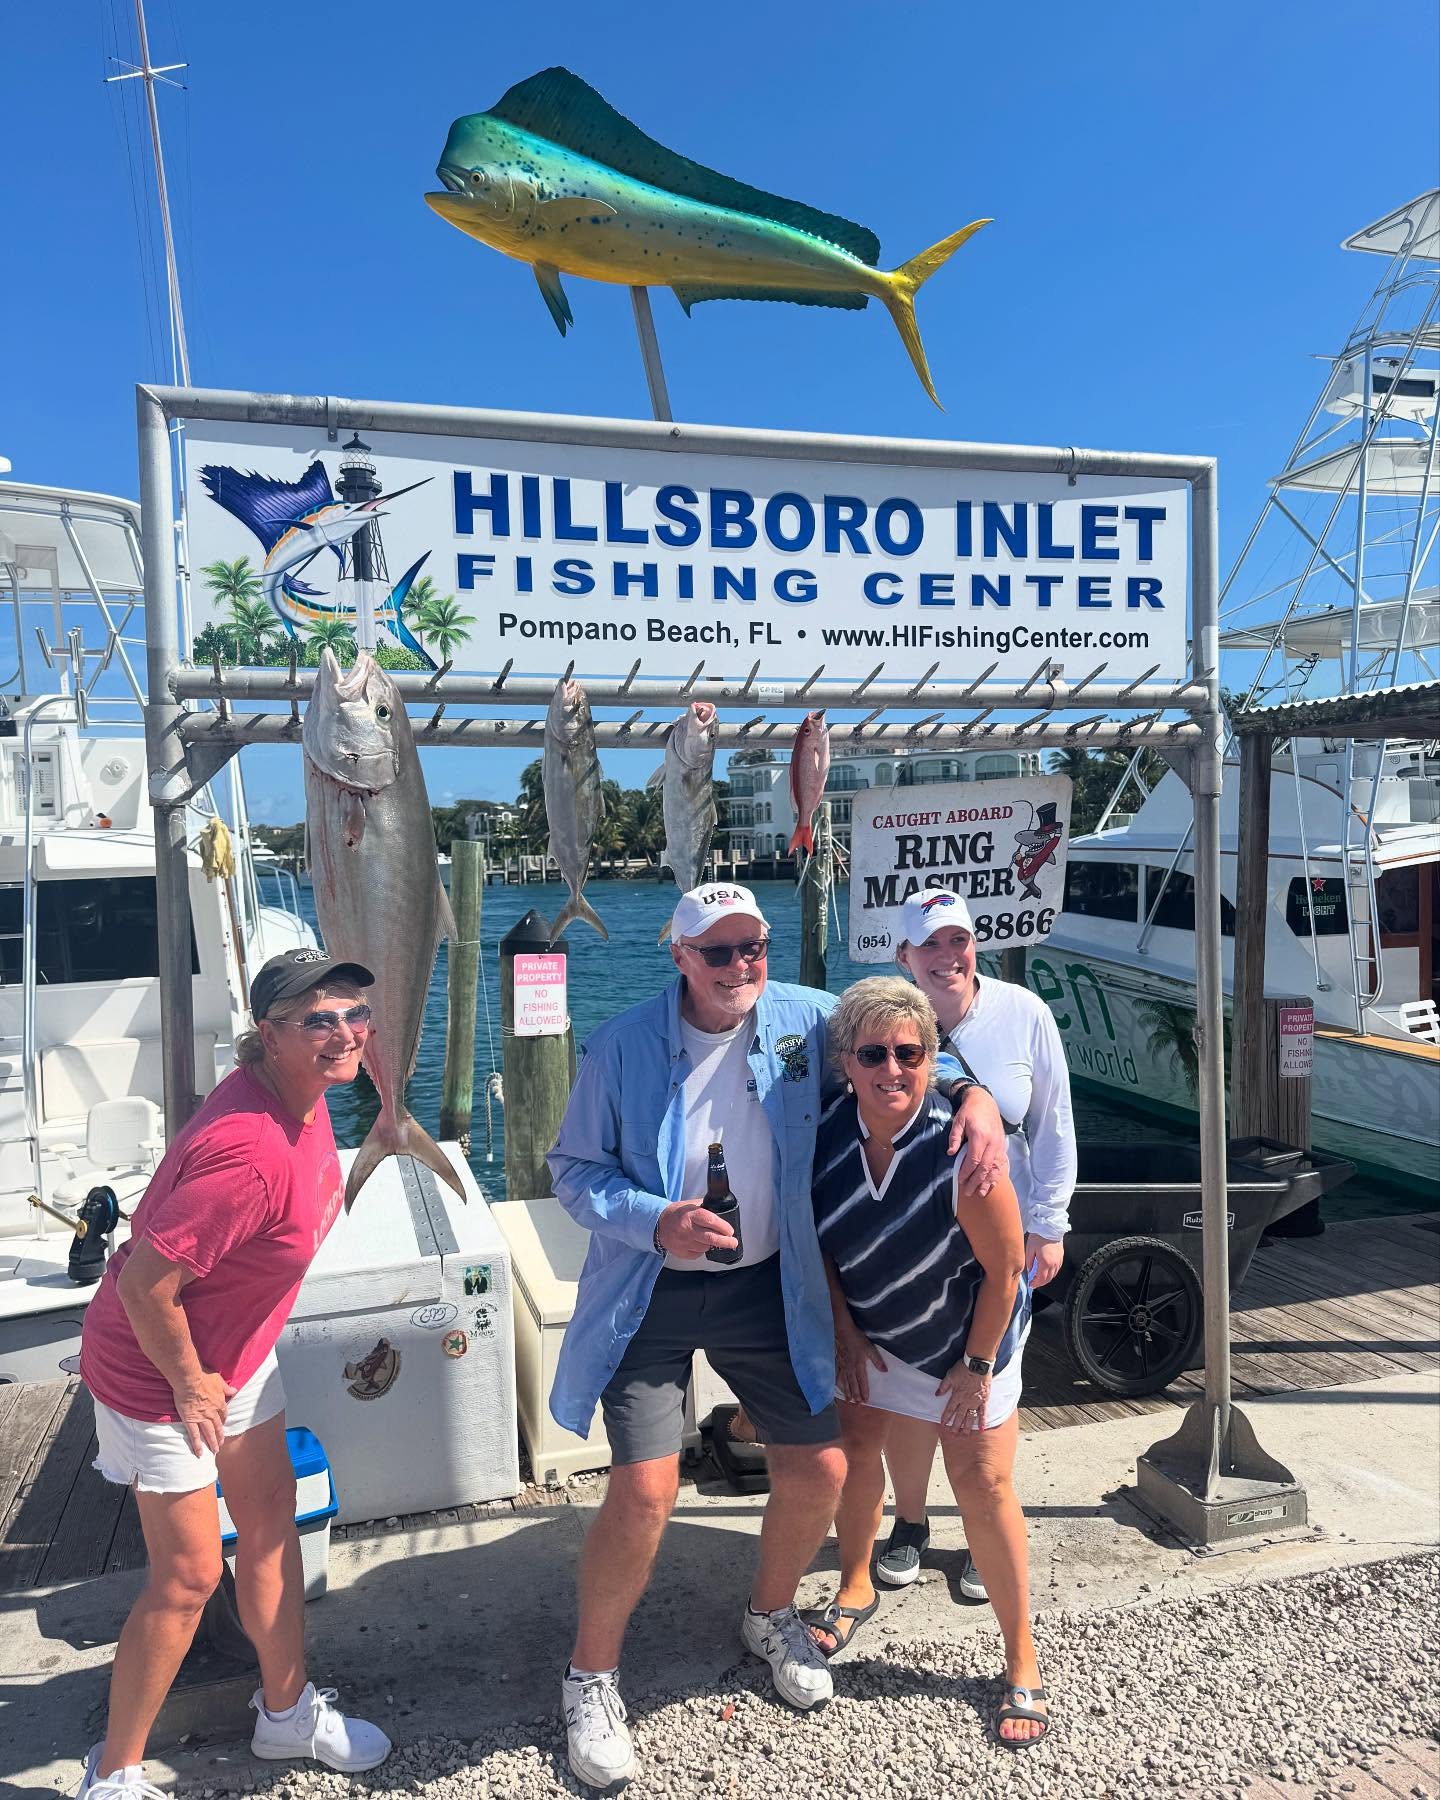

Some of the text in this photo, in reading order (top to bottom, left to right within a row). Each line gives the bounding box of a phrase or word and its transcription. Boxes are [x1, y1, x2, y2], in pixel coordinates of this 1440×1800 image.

[453, 469, 1167, 561] HILLSBORO INLET
[456, 553, 1166, 609] FISHING CENTER
[499, 613, 1149, 653] Pompano Beach, FL www.HIFishingCenter.com
[872, 805, 1013, 829] CAUGHT ABOARD
[893, 831, 994, 870] RING
[862, 867, 1015, 911] MASTER
[702, 890, 744, 905] USA
[1295, 893, 1341, 905] Heneken
[1302, 905, 1336, 917] LGHT
[857, 907, 1055, 950] (954) 8866
[521, 961, 559, 971] PRIVATE
[517, 973, 562, 982] PROPERTY
[534, 989, 548, 998] NO
[523, 1002, 559, 1013] FISHING
[519, 1015, 563, 1026] ALLOWED
[1282, 1023, 1313, 1032] PROPERT
[1297, 1037, 1308, 1046] NO
[1076, 1043, 1139, 1085] world
